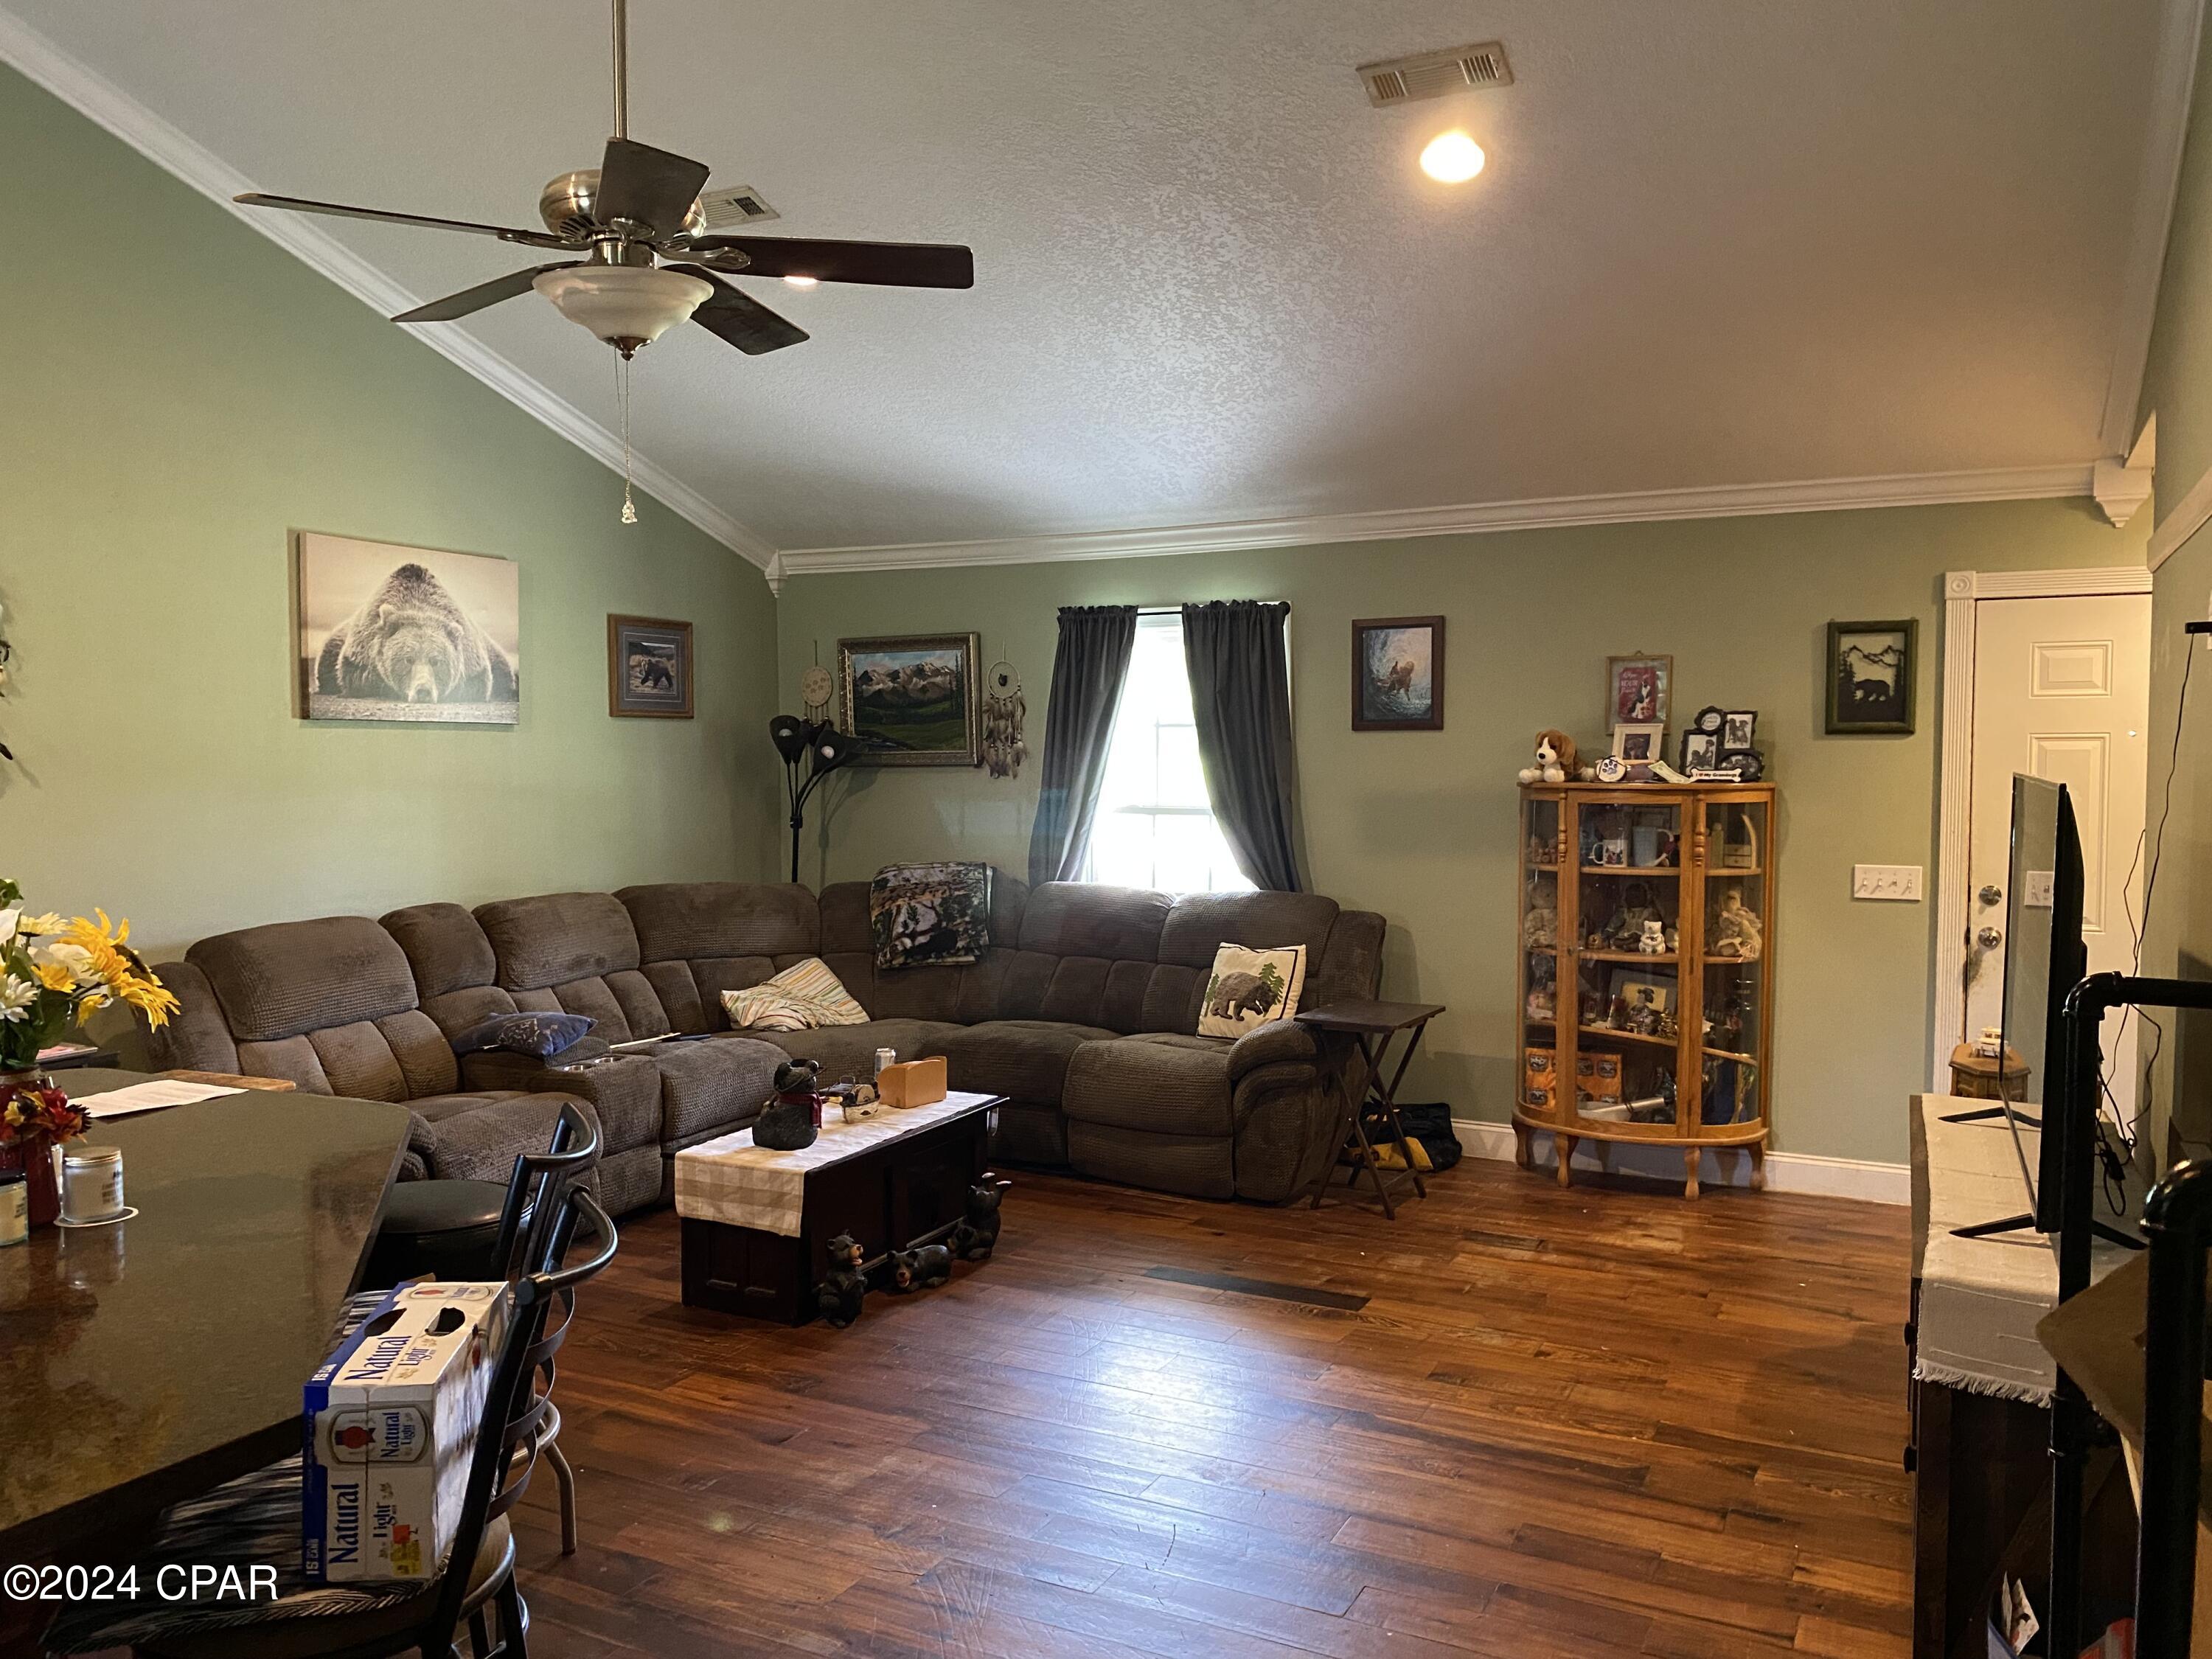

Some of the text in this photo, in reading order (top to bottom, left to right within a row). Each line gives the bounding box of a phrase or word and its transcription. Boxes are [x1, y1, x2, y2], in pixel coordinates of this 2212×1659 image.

[344, 1336, 412, 1380] Natural
[398, 1347, 433, 1366] Light
[380, 1412, 400, 1457] Natural
[327, 1483, 359, 1564] Natural
[372, 1501, 397, 1538] Light
